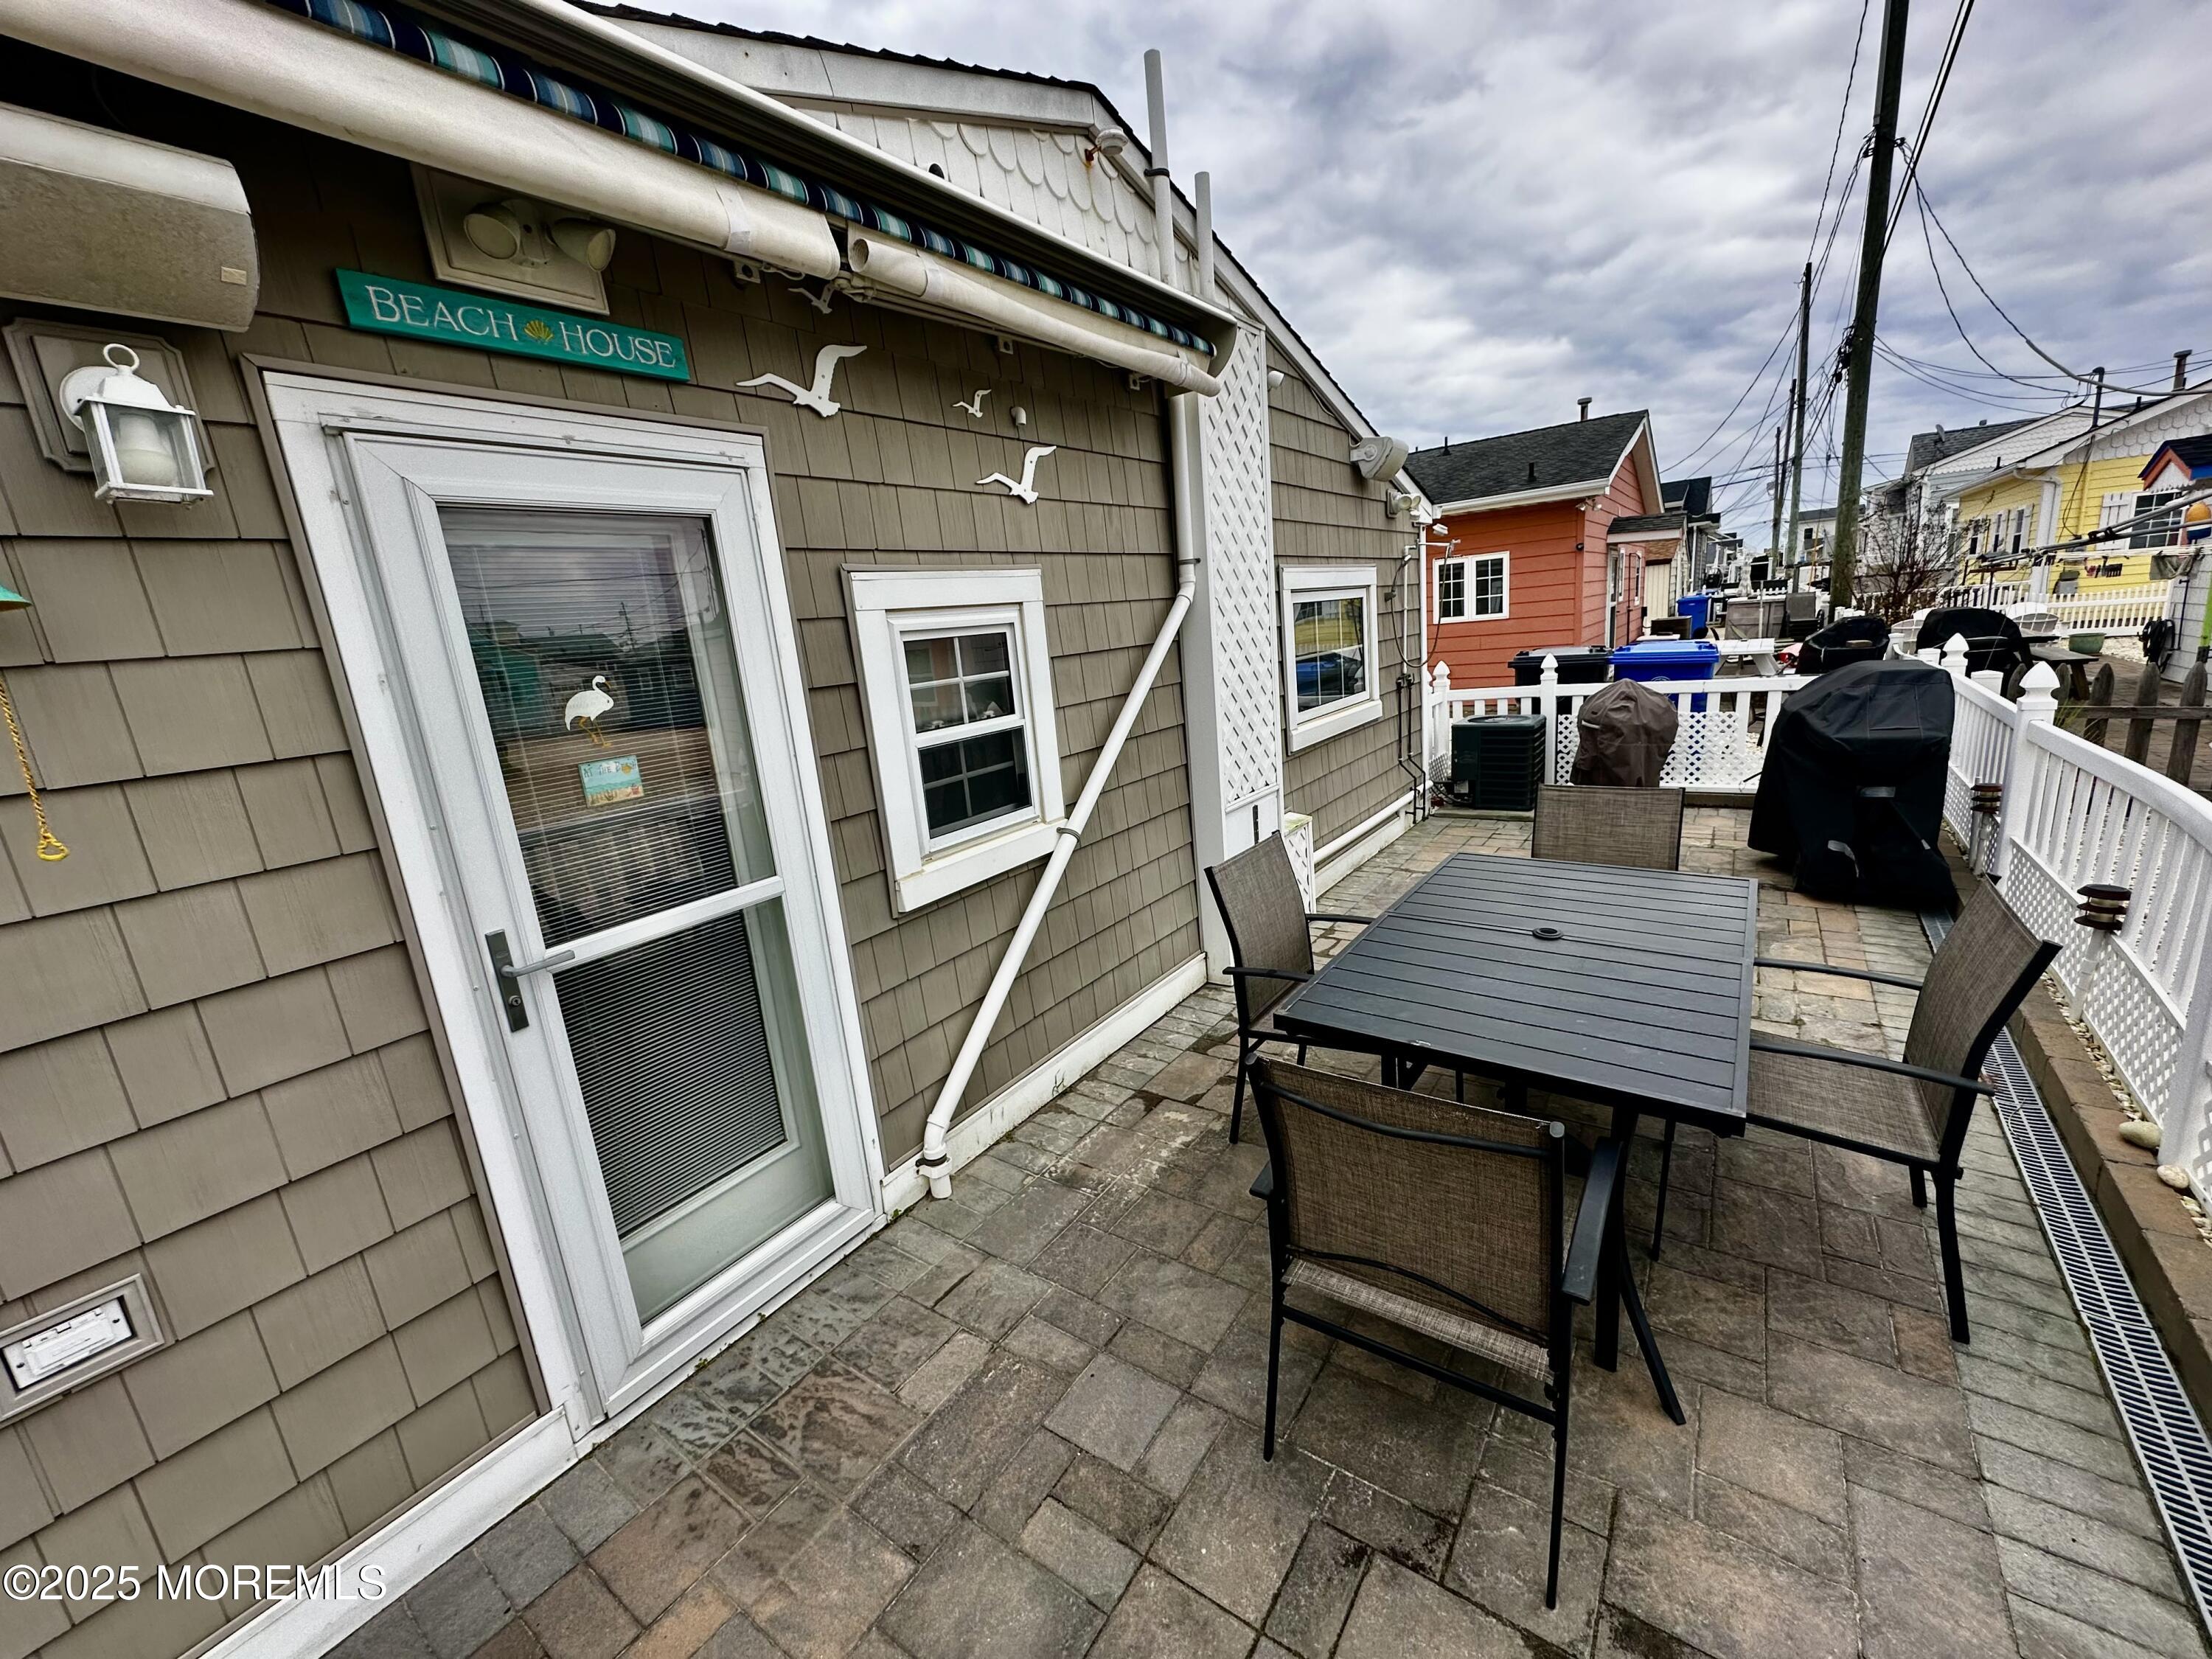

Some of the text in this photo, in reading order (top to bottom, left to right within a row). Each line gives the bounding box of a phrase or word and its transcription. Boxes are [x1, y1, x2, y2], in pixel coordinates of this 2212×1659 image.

[365, 285, 676, 369] BEACH HOUSE
[583, 767, 593, 778] AT
